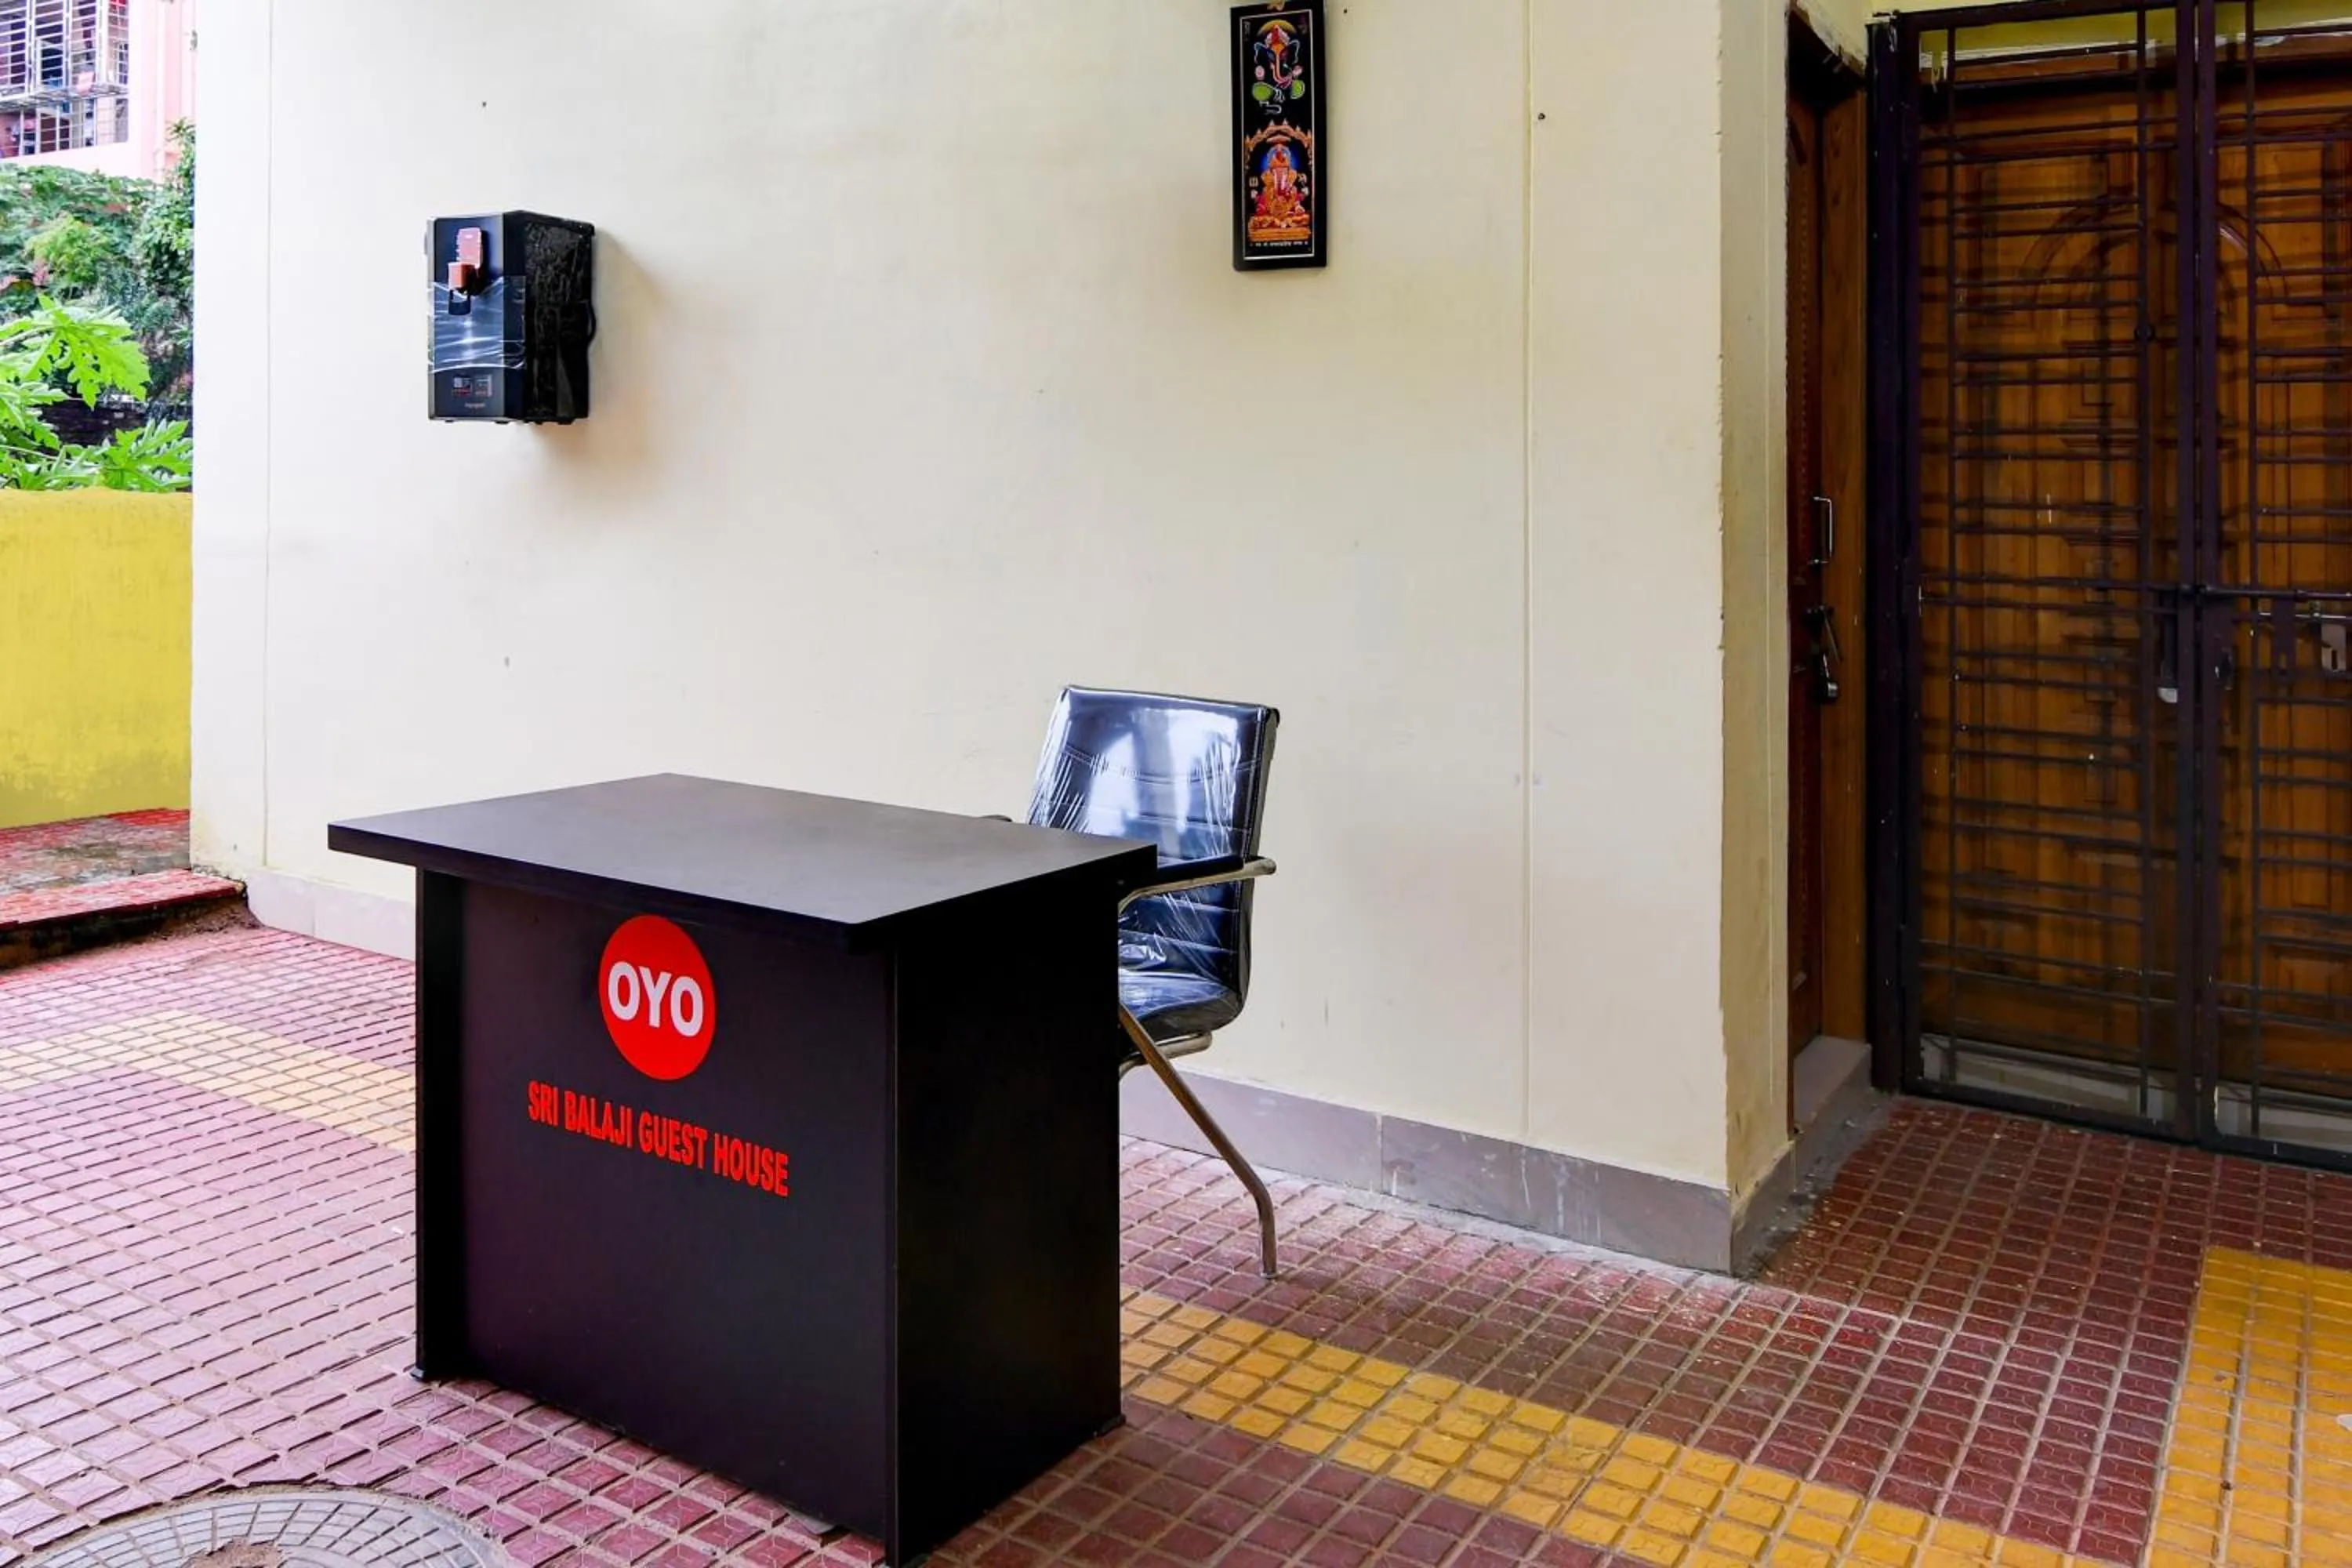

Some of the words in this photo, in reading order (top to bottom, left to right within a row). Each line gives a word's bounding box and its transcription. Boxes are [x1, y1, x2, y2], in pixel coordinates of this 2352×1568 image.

[608, 961, 703, 1036] OYO
[528, 1080, 559, 1127] SRI
[564, 1090, 633, 1149] BALAJI
[638, 1110, 708, 1169] GUEST
[713, 1133, 789, 1197] HOUSE
